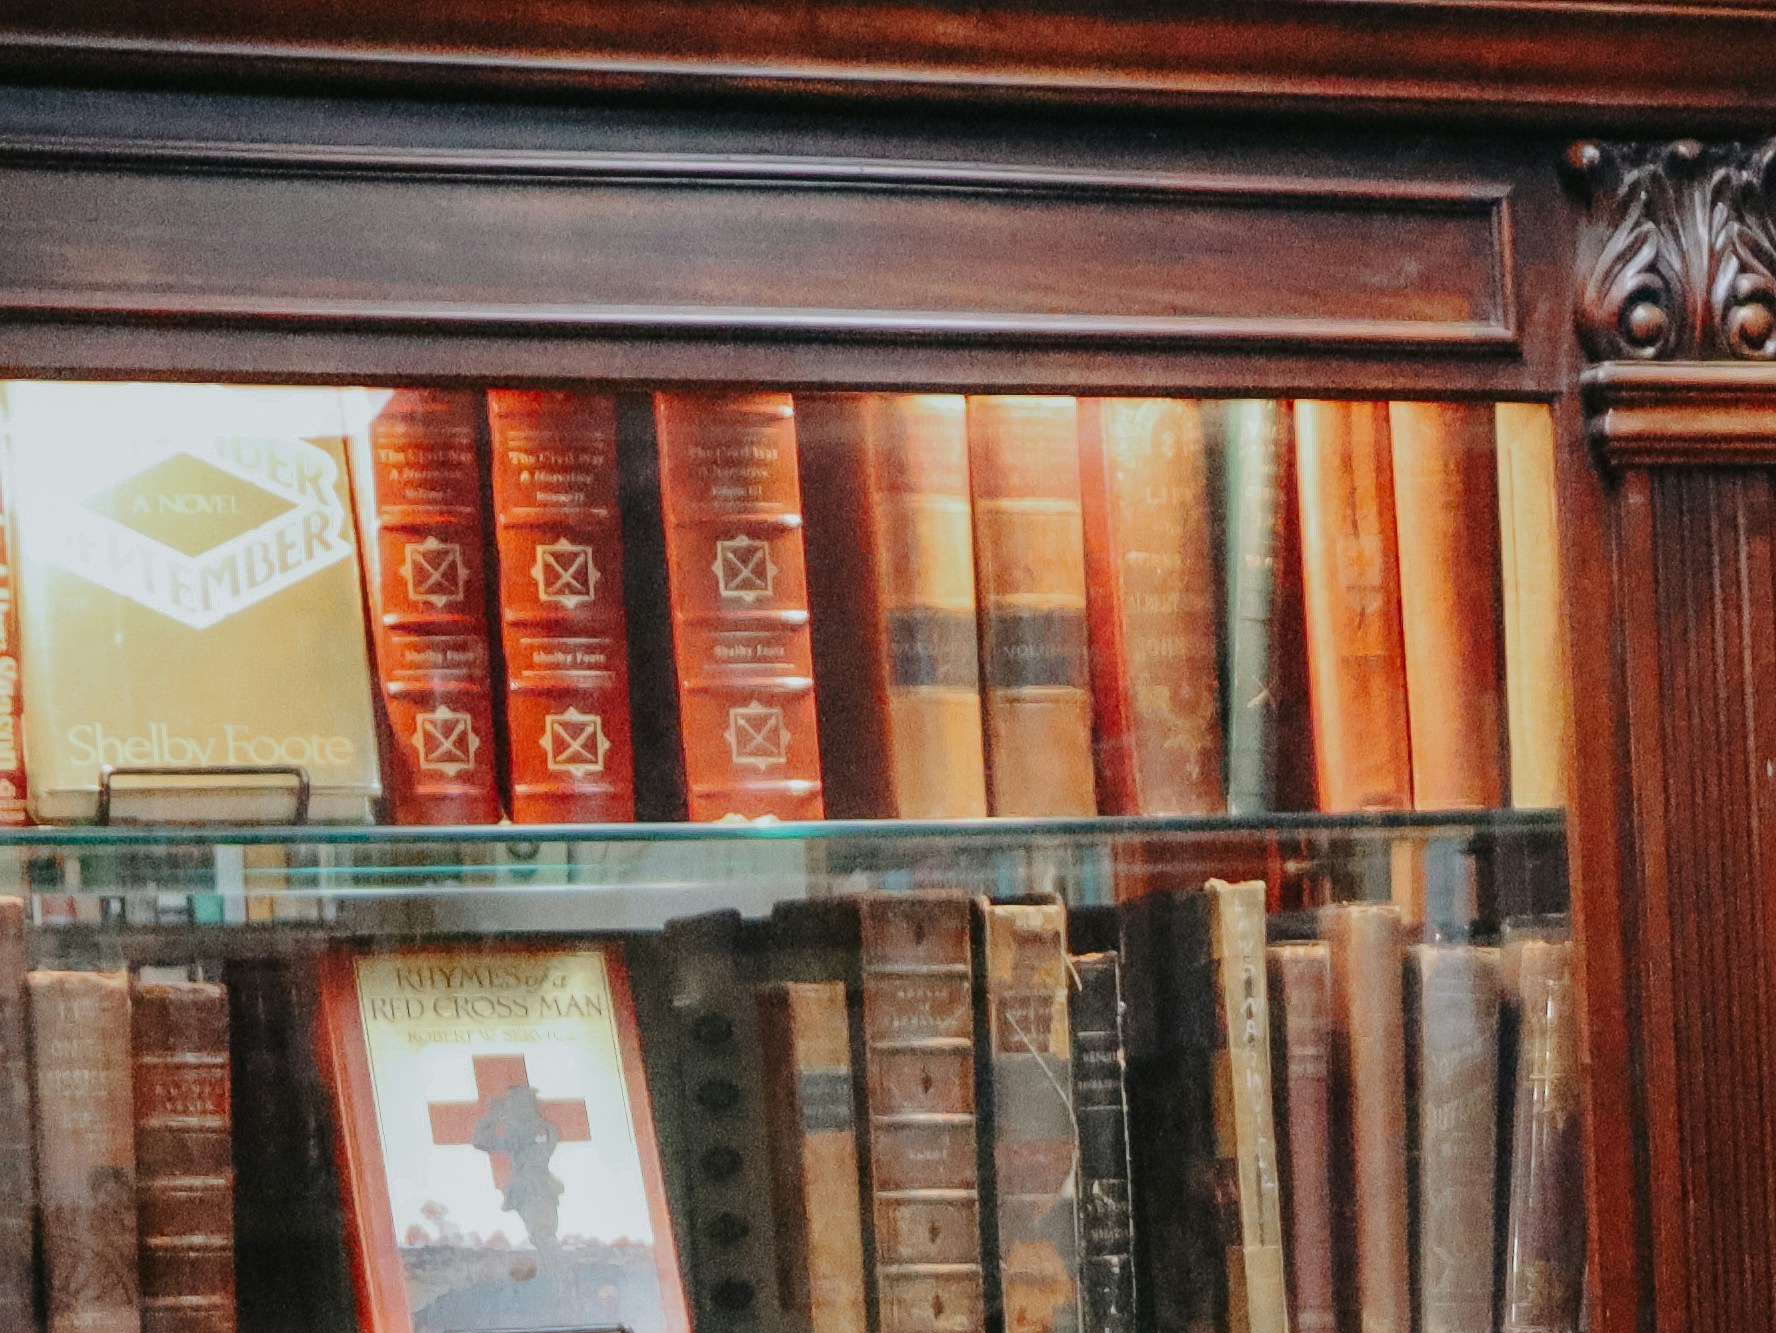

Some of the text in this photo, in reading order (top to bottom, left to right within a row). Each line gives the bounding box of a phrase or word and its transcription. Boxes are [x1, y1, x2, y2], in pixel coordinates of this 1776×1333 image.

[158, 493, 239, 515] NOVEL
[66, 721, 355, 768] Shelby Foote
[396, 964, 521, 991] RHYMES
[371, 994, 603, 1024] RED CROSS MAN
